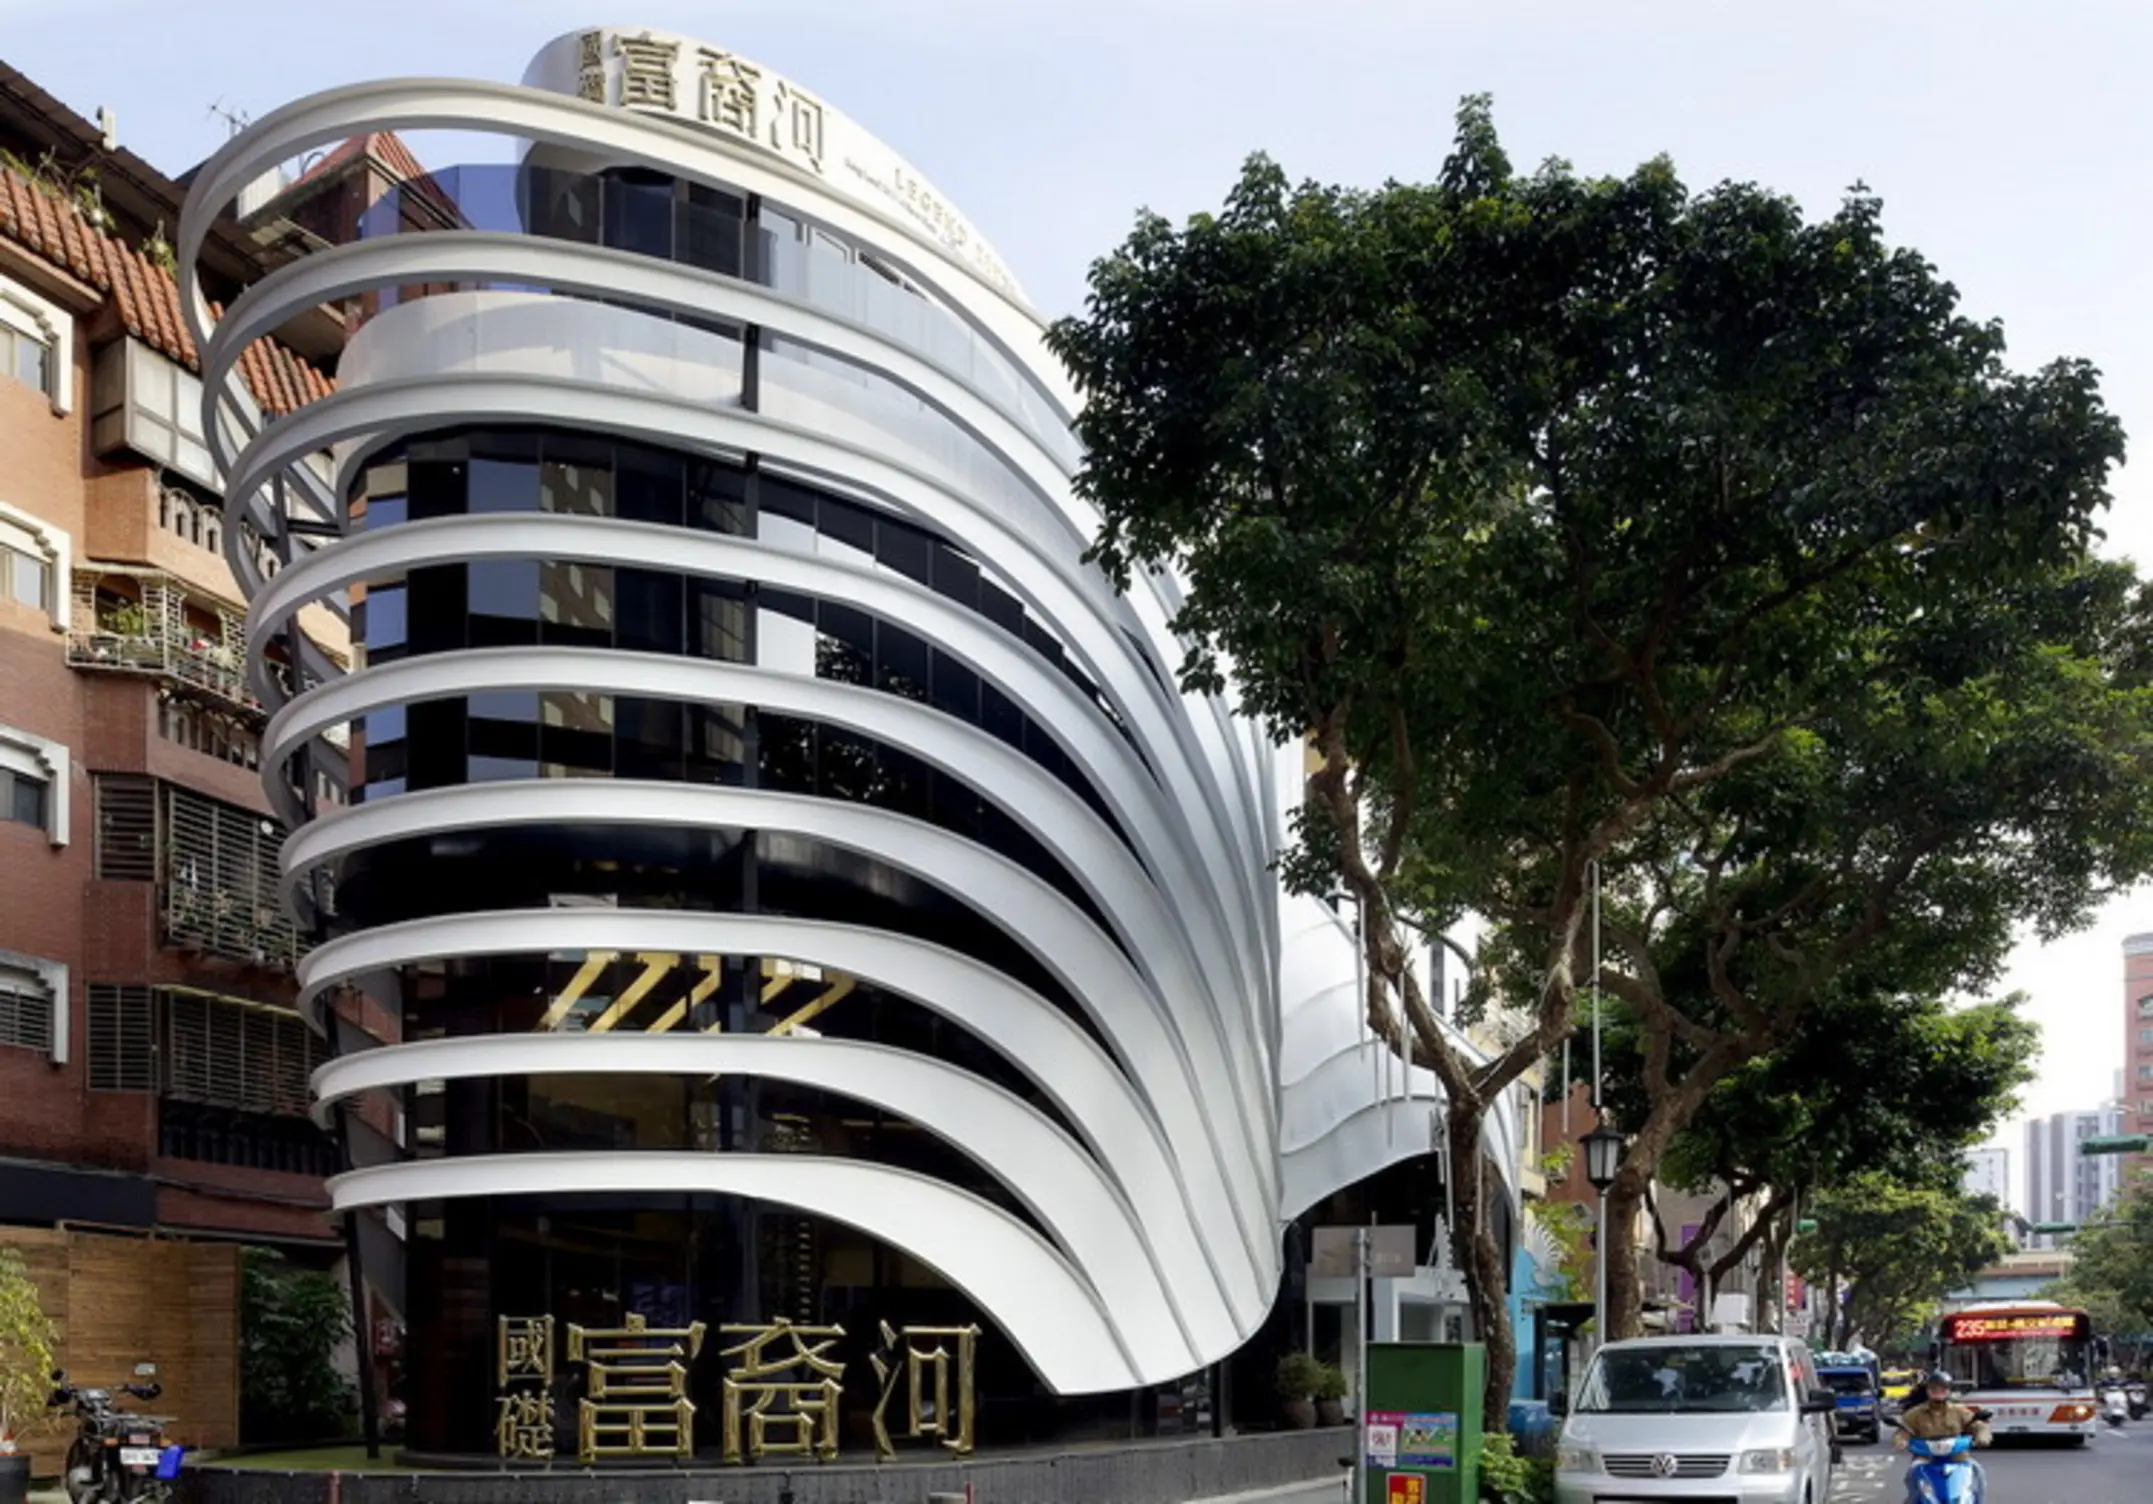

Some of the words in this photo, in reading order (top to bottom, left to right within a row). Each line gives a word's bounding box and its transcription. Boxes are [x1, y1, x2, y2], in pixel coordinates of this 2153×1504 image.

[496, 1313, 554, 1461] 國礎
[566, 1312, 983, 1466] 富裔河
[1955, 1318, 1985, 1338] 235
